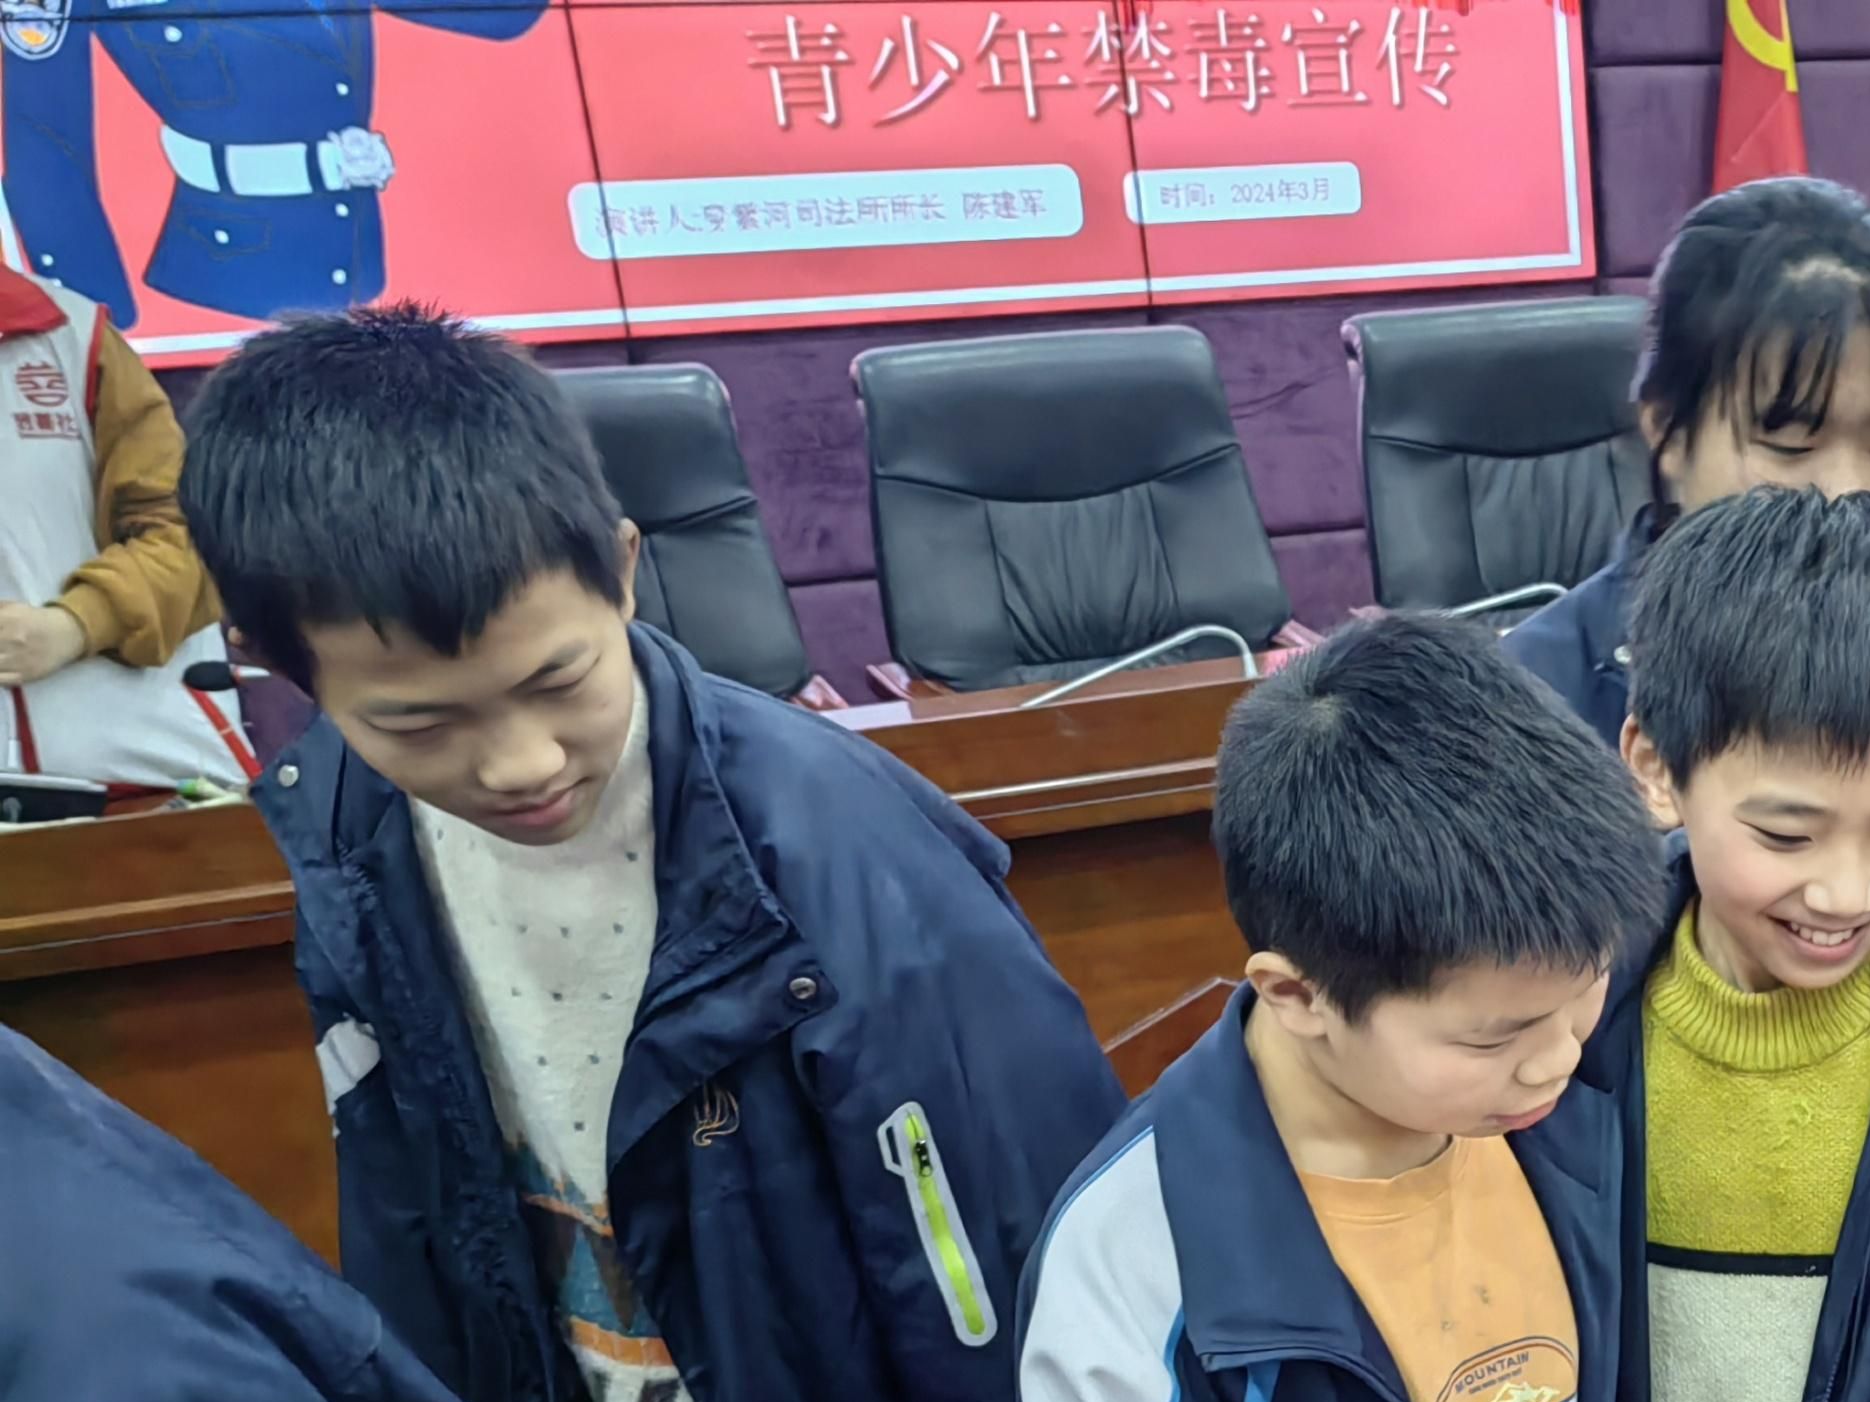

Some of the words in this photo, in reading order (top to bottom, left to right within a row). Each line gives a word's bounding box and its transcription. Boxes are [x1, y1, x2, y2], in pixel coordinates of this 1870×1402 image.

[747, 8, 1460, 130] 青少年禁毒宣传
[1455, 1351, 1530, 1393] MOUNTAIN
